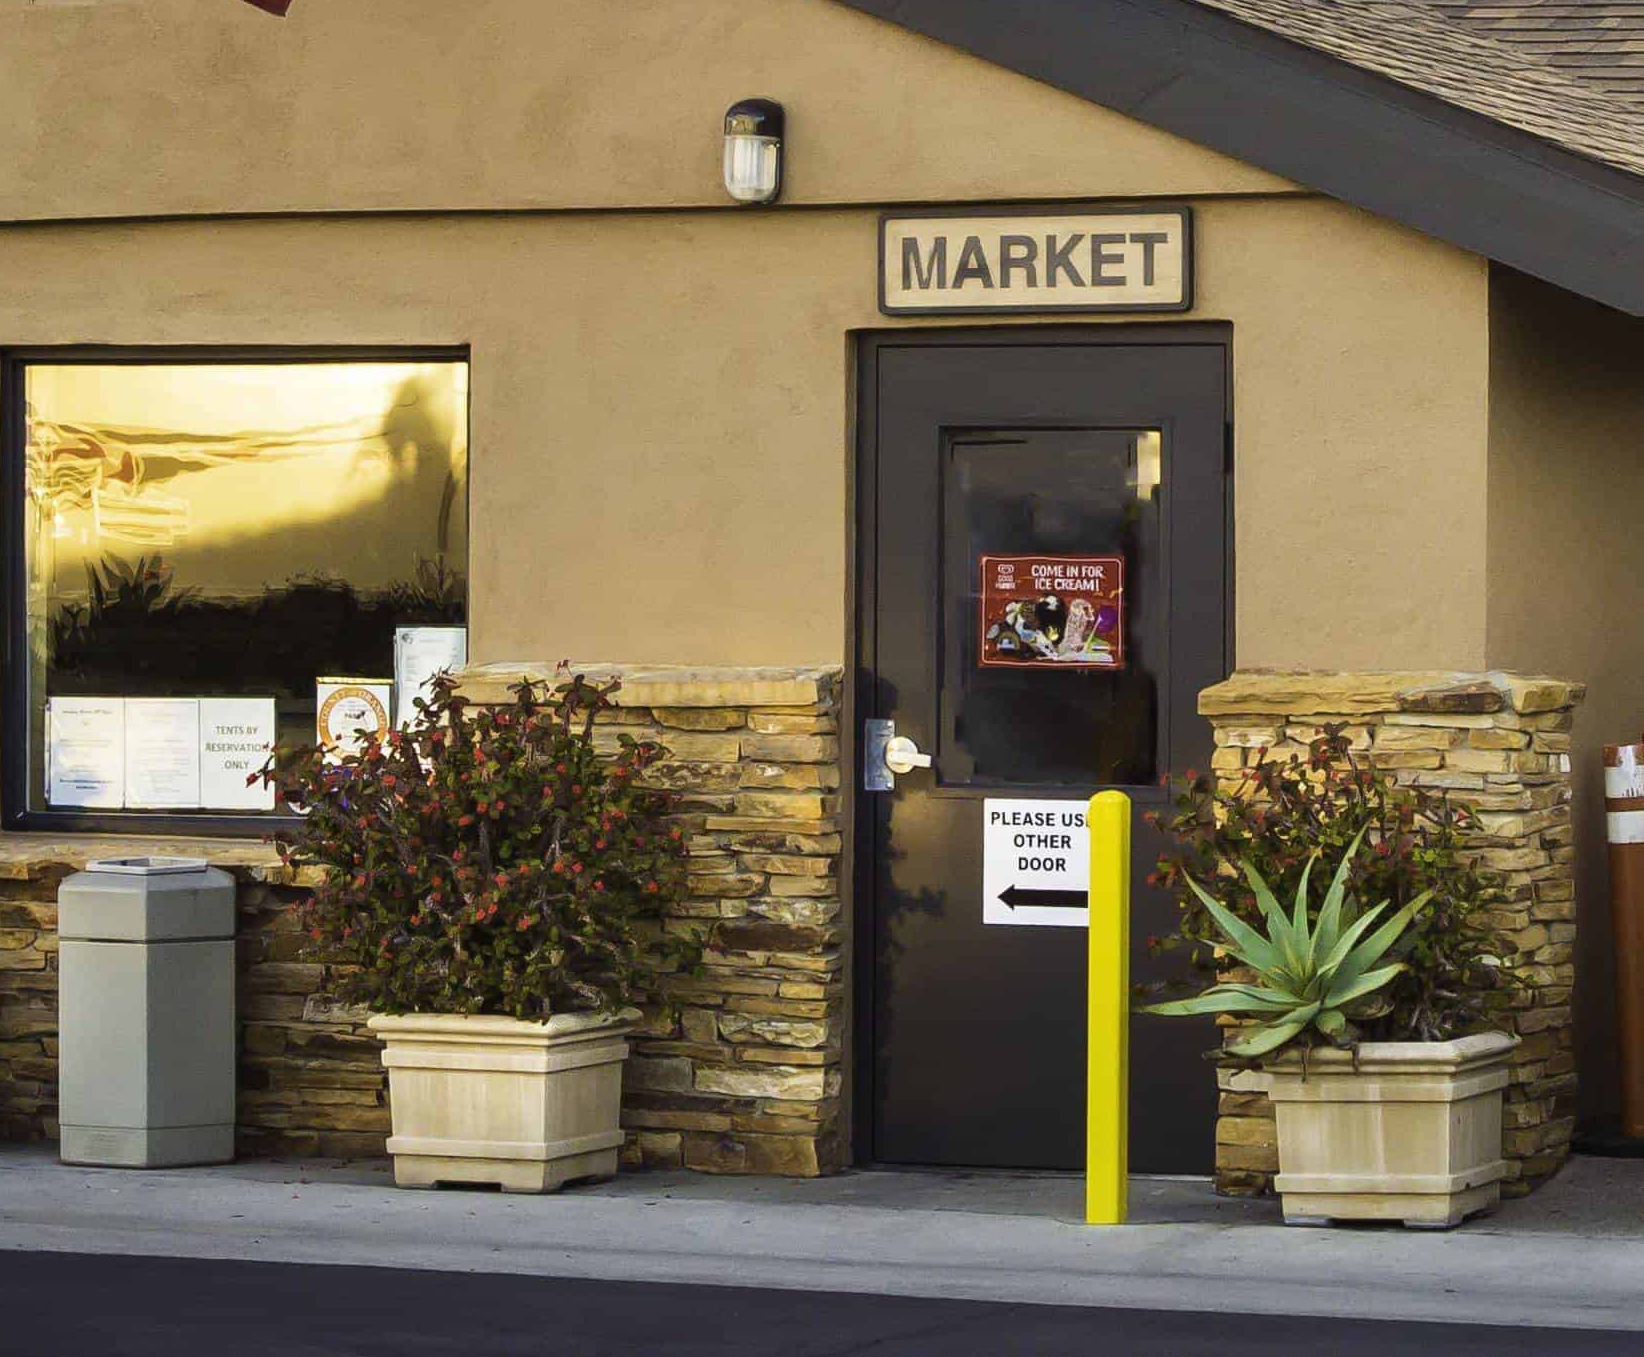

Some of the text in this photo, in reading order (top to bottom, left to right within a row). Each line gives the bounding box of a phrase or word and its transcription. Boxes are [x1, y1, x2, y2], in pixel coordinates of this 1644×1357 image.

[901, 232, 1168, 290] MARKET
[1031, 565, 1104, 578] COME IN FOR
[1034, 578, 1099, 591] ICE CREAM!
[216, 726, 259, 735] TENTS BY
[224, 760, 250, 770] ONLY
[991, 811, 1091, 828] PLEASE US
[1013, 834, 1072, 849] OTHER
[1018, 857, 1066, 872] DOOR
